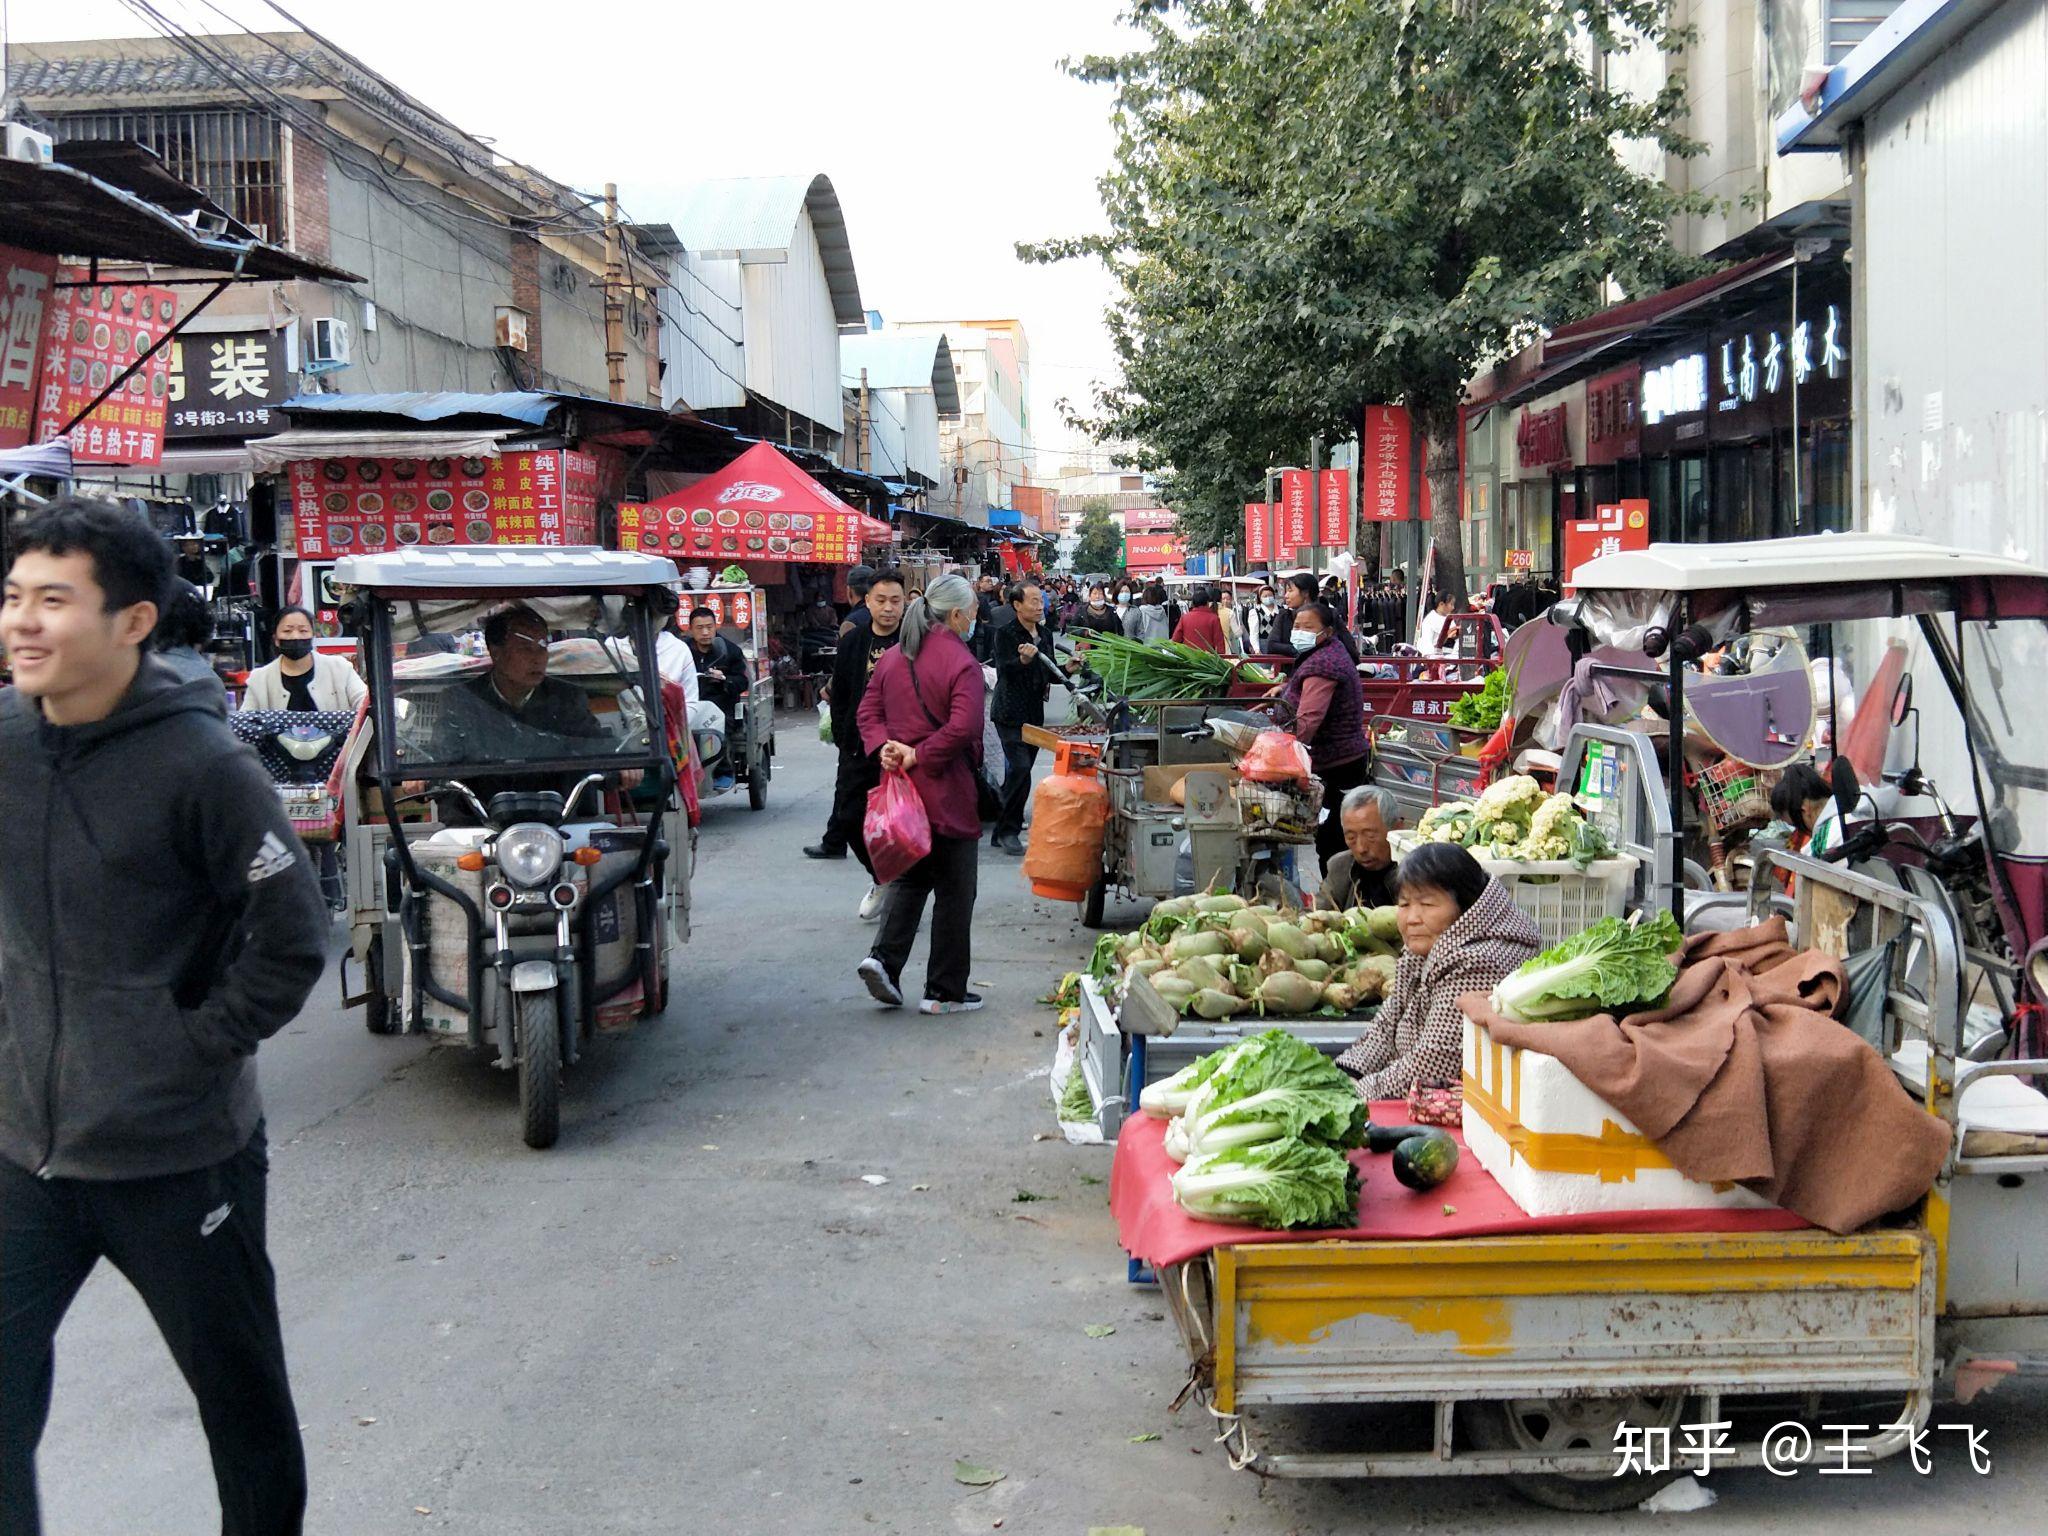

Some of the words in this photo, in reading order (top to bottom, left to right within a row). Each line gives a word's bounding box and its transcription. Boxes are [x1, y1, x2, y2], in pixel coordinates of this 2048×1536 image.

[174, 409, 271, 427] 3号街3-13号
[71, 424, 156, 459] 特色热干面
[1376, 433, 1400, 517] 南方啄木鸟品牌男装
[295, 462, 322, 554] 特色热干面
[535, 454, 561, 546] 纯手工制作
[1512, 552, 1533, 566] 260
[735, 597, 749, 624] 米皮
